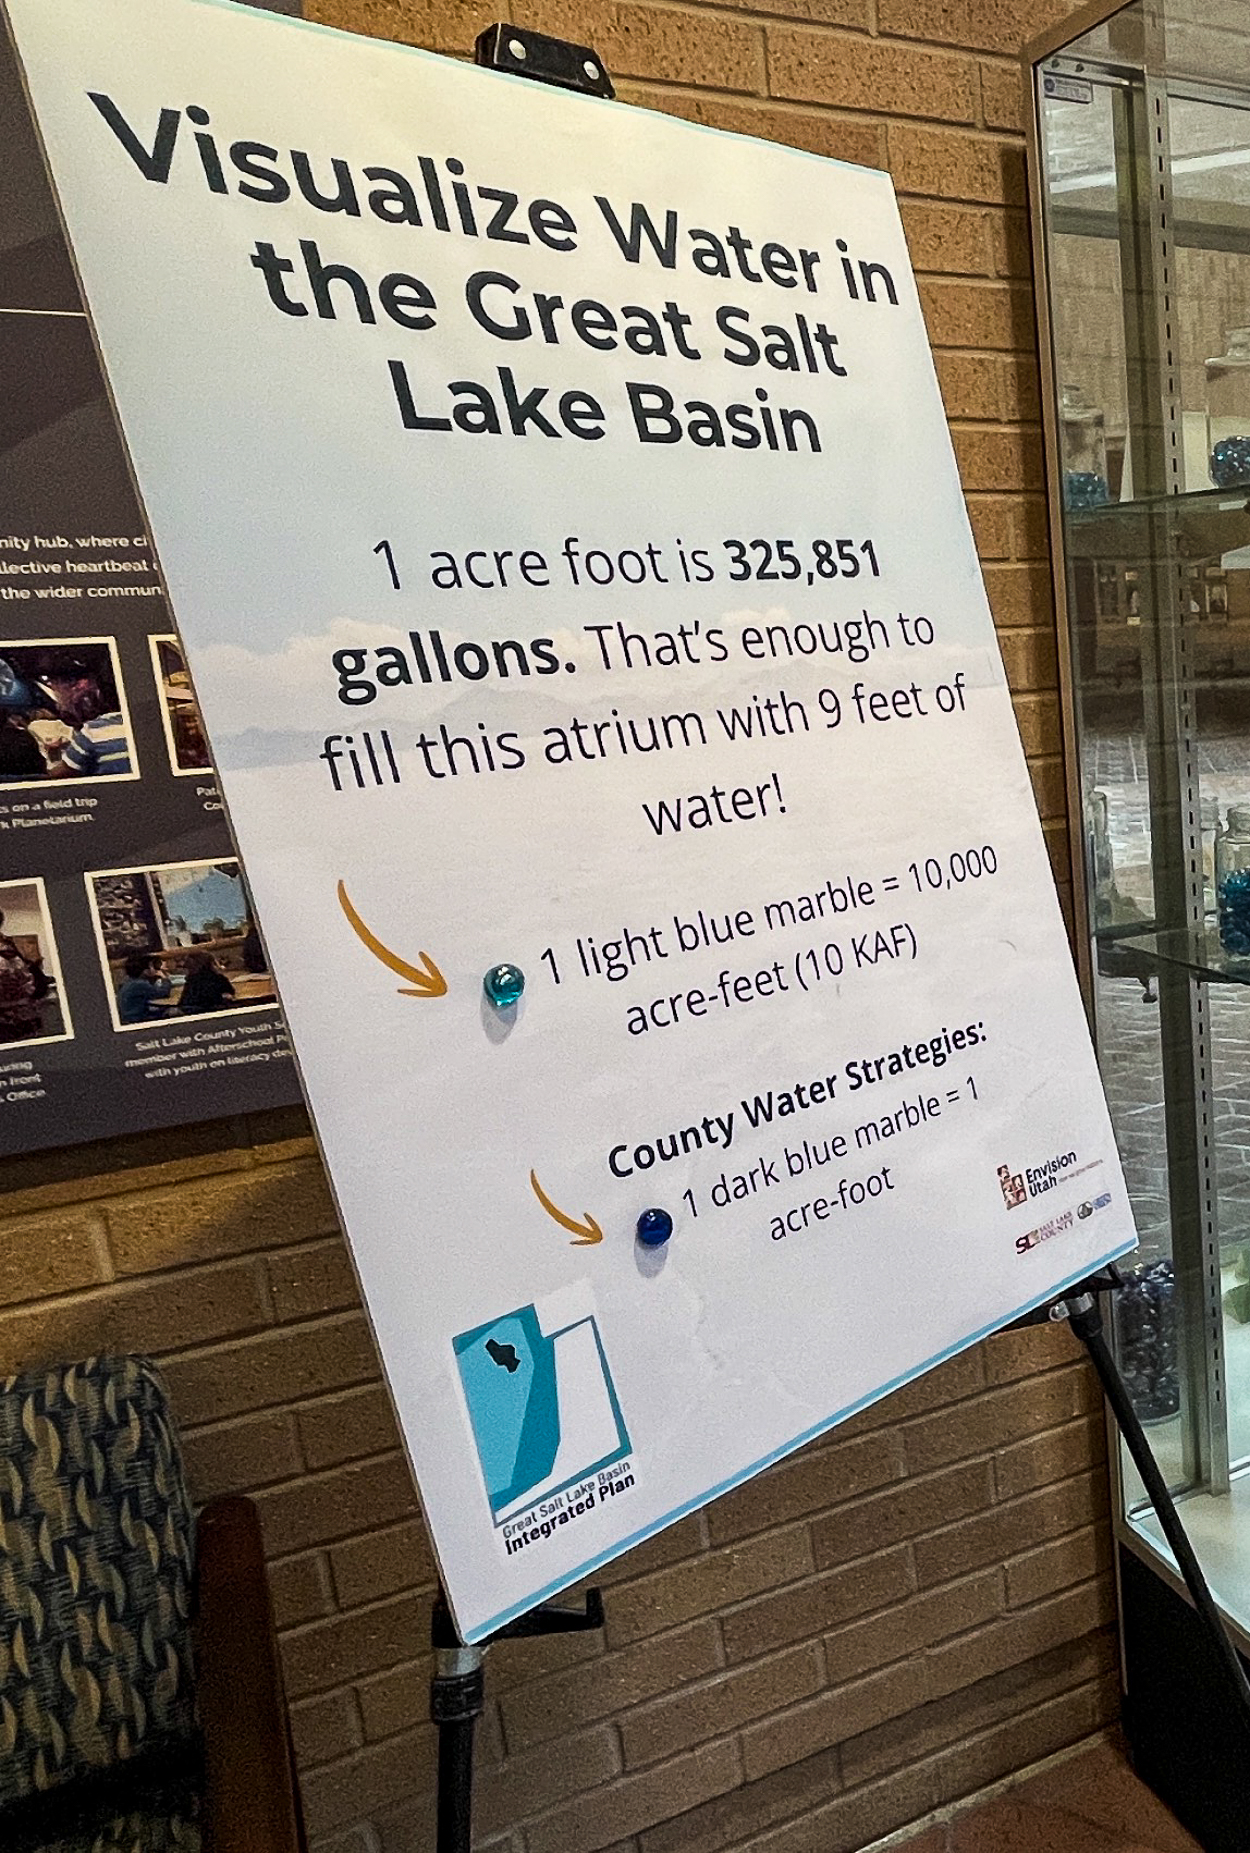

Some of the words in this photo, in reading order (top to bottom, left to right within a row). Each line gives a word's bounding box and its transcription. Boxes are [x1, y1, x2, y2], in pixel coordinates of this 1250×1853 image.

[87, 92, 577, 251] Visualize
[593, 196, 820, 293] Water
[836, 239, 899, 305] in
[250, 239, 437, 330] the
[466, 271, 701, 360] Great
[716, 306, 847, 376] Salt
[388, 360, 605, 440] Lake
[625, 382, 821, 452] Basin
[65, 559, 149, 573] heartbeat
[75, 535, 130, 548] where
[373, 540, 400, 590] 1
[430, 551, 549, 589] acre
[562, 537, 668, 585] foot
[676, 539, 714, 582] is
[723, 539, 880, 586] 325,851
[1, 586, 31, 600] the
[34, 585, 83, 599] wider
[332, 630, 575, 705] gallons.
[584, 620, 728, 670] That's
[742, 610, 890, 663] enough
[897, 613, 933, 646] to
[319, 730, 400, 790] fill
[416, 723, 525, 778] this
[543, 709, 707, 763] atrium
[716, 691, 809, 740] with
[819, 689, 841, 728] 9
[852, 683, 928, 723] feet
[936, 673, 965, 712] of
[43, 798, 73, 810] field
[75, 797, 98, 808] trip
[642, 773, 786, 835] water!
[541, 948, 560, 984] 1
[577, 927, 668, 981] light
[674, 910, 755, 952] blue
[764, 876, 875, 930] marble
[882, 877, 899, 891] =
[909, 846, 997, 892] 10,000
[627, 962, 788, 1035] acre-feet
[796, 944, 843, 991] (10
[851, 923, 916, 968] KAF)
[124, 1052, 177, 1068] member
[178, 1048, 206, 1059] with
[208, 1036, 275, 1054] Afterschool
[135, 1039, 161, 1052] Salt
[162, 1035, 192, 1047] Lake
[193, 1029, 237, 1042] County
[237, 1023, 272, 1035] Youth
[145, 1067, 172, 1079] with
[172, 1062, 208, 1076] youth
[209, 1059, 226, 1069] on
[226, 1052, 271, 1065] literacy
[609, 1113, 733, 1177] County
[741, 1075, 837, 1128] Water
[846, 1022, 986, 1090] Strategies:
[683, 1189, 697, 1217] 1
[712, 1158, 780, 1206] dark
[784, 1137, 847, 1177] blue
[855, 1095, 941, 1148] marble
[946, 1090, 959, 1103] =
[967, 1076, 977, 1100] 1
[1026, 1152, 1076, 1184] Envision
[770, 1167, 894, 1240] acre-foot
[1029, 1175, 1057, 1197] Utah
[503, 1512, 537, 1538] Great
[540, 1498, 563, 1517] Salt
[566, 1482, 594, 1502] Lake
[598, 1462, 630, 1485] Basin
[506, 1493, 595, 1555] Integrated
[599, 1475, 634, 1502] Plan
